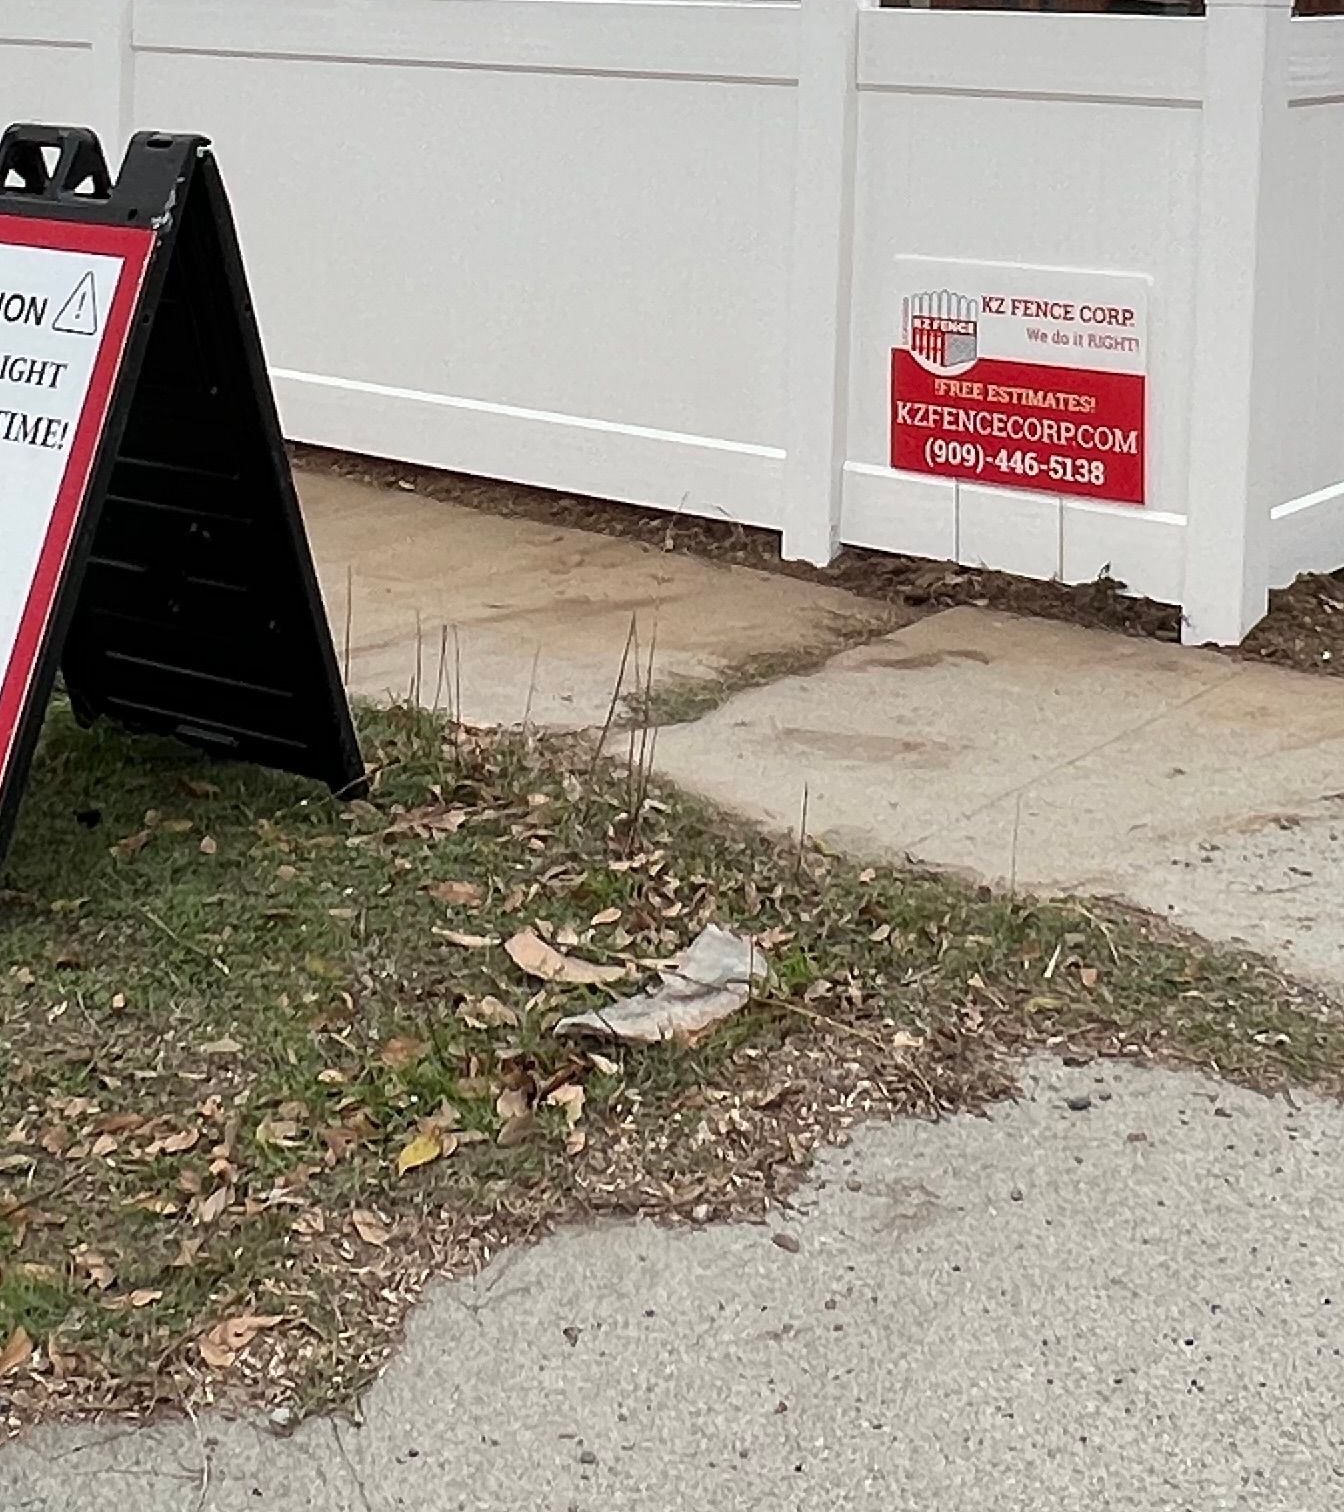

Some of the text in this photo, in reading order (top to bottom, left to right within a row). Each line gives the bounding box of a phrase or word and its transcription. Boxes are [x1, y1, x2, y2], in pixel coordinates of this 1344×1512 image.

[981, 295, 1135, 327] KZ FENCE CORP.
[1026, 327, 1047, 343] We
[1052, 329, 1070, 346] do
[1073, 331, 1084, 348] it
[987, 385, 1096, 413] ESTIMATES!
[896, 401, 1138, 454] KZFENCECORP.COM
[924, 438, 1106, 485] (909)-446-5138
